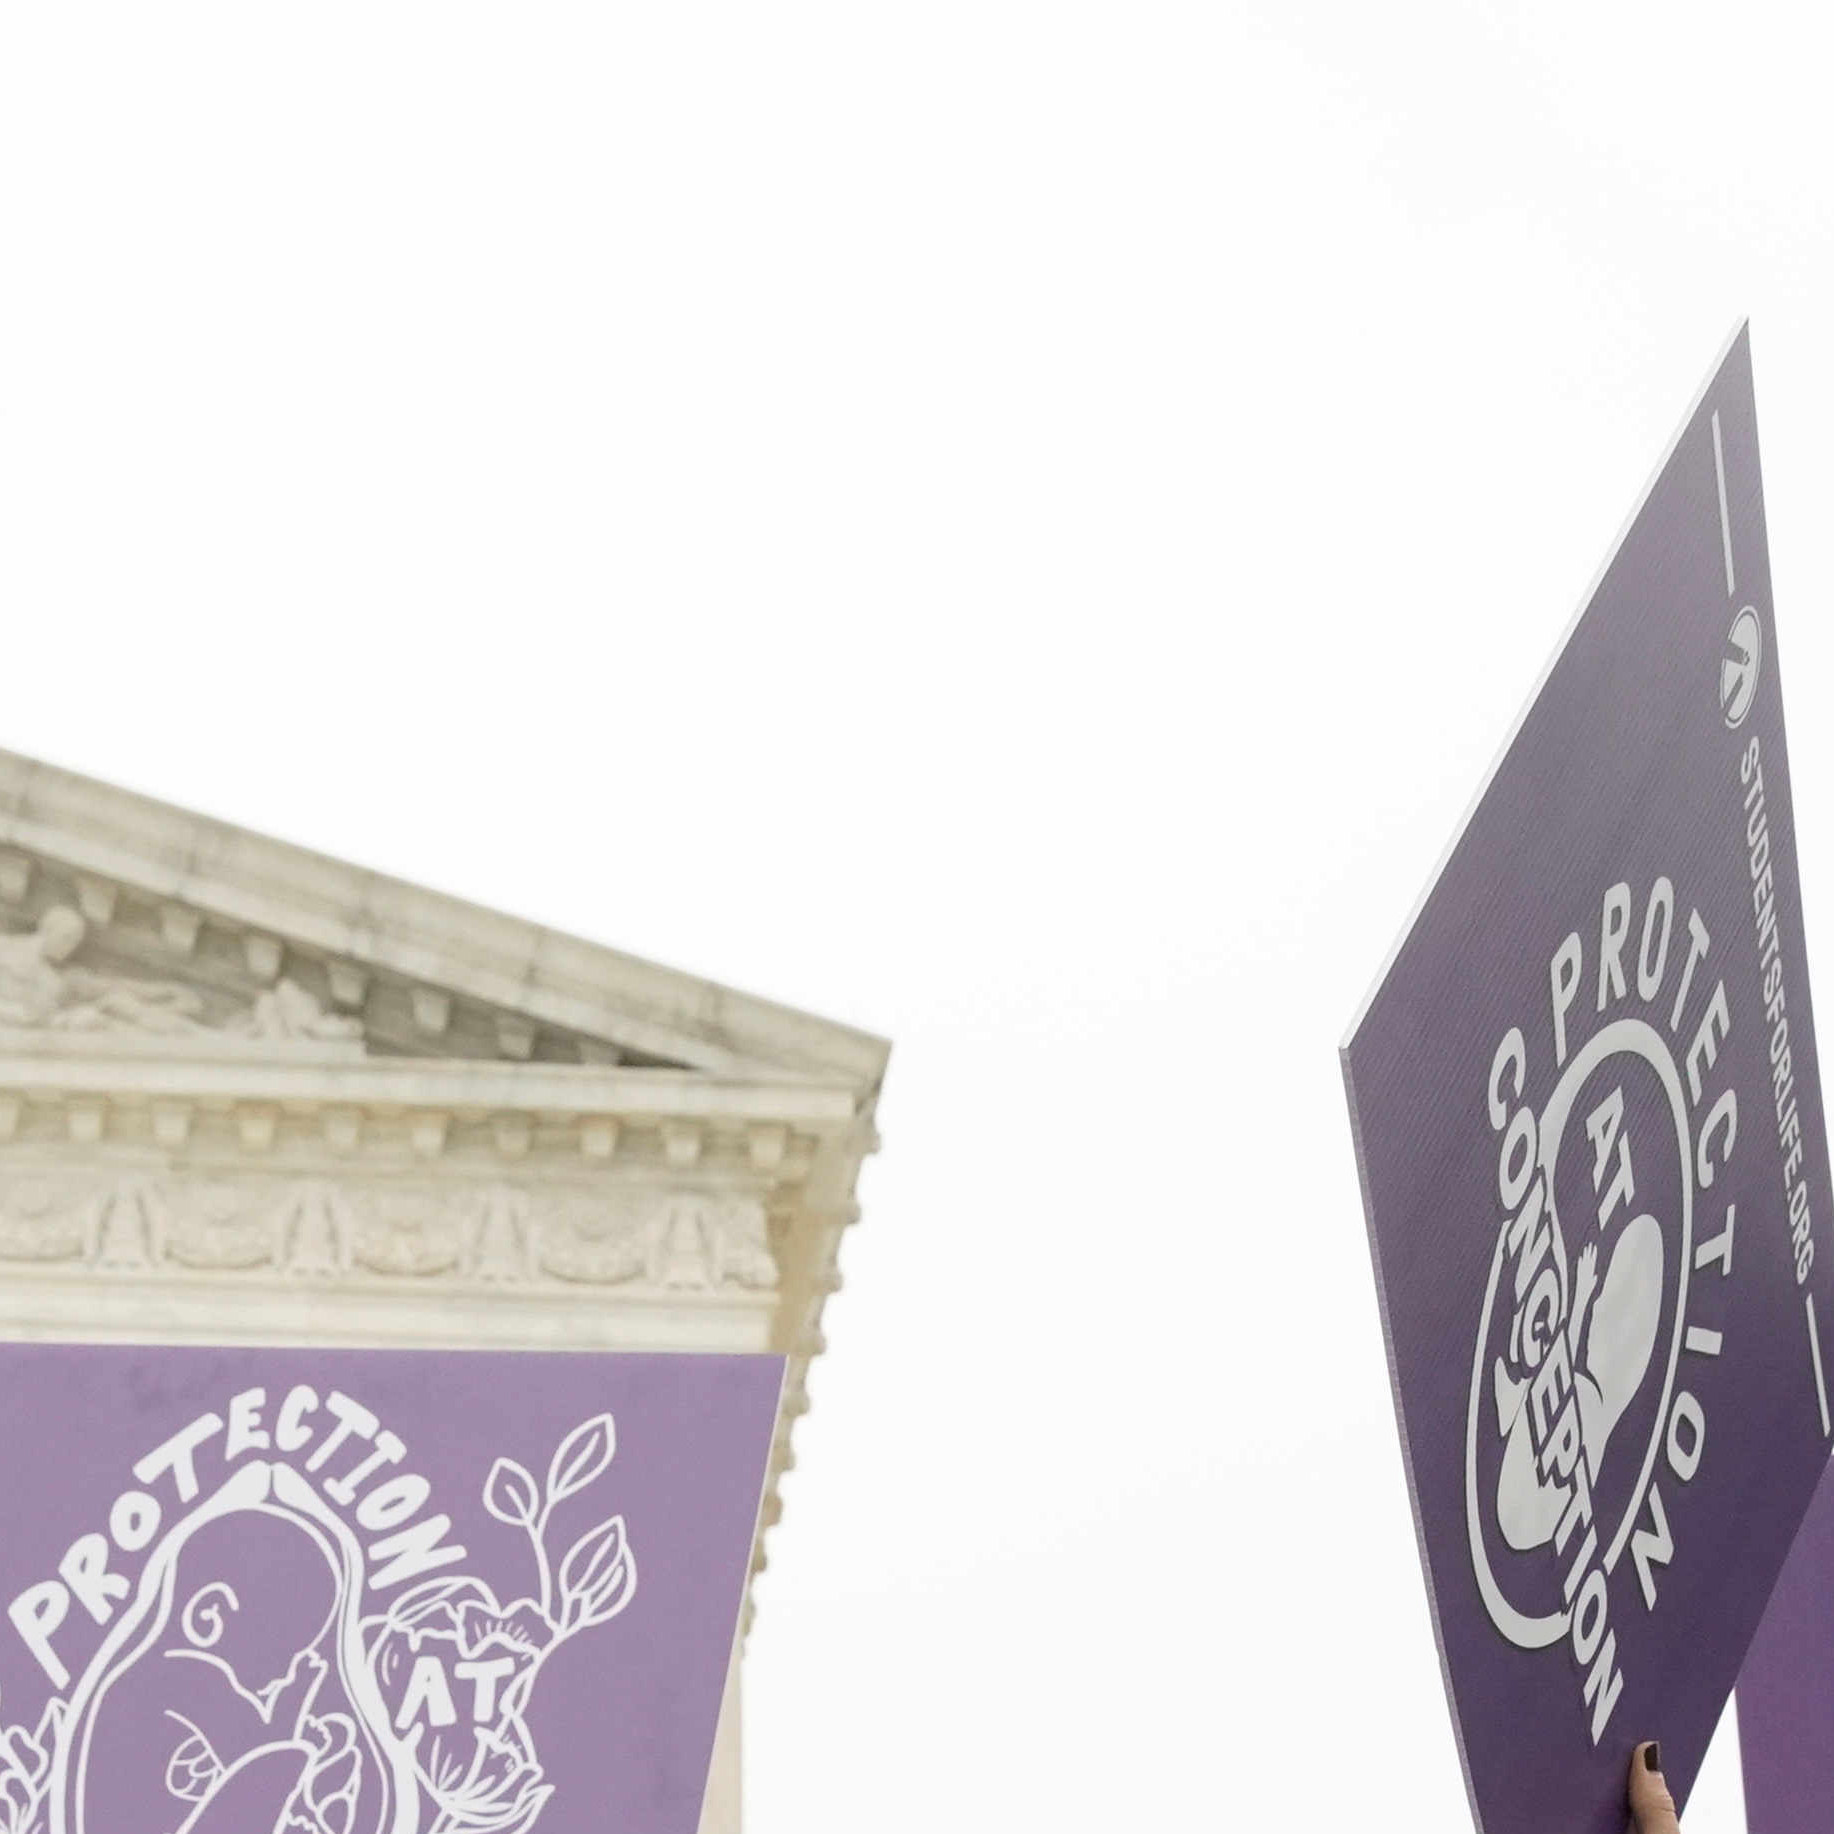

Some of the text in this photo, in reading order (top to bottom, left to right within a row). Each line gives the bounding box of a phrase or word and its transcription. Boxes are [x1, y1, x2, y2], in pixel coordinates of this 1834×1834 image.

[1585, 1085, 1637, 1235] AT
[1740, 735, 1815, 1287] STUDENTSFORLIFE.ORG
[1487, 1026, 1624, 1746] CONCEPTION
[1551, 876, 1739, 1611] PROTECTION
[7, 1385, 467, 1688] PROTECTION
[394, 1656, 516, 1730] AT
